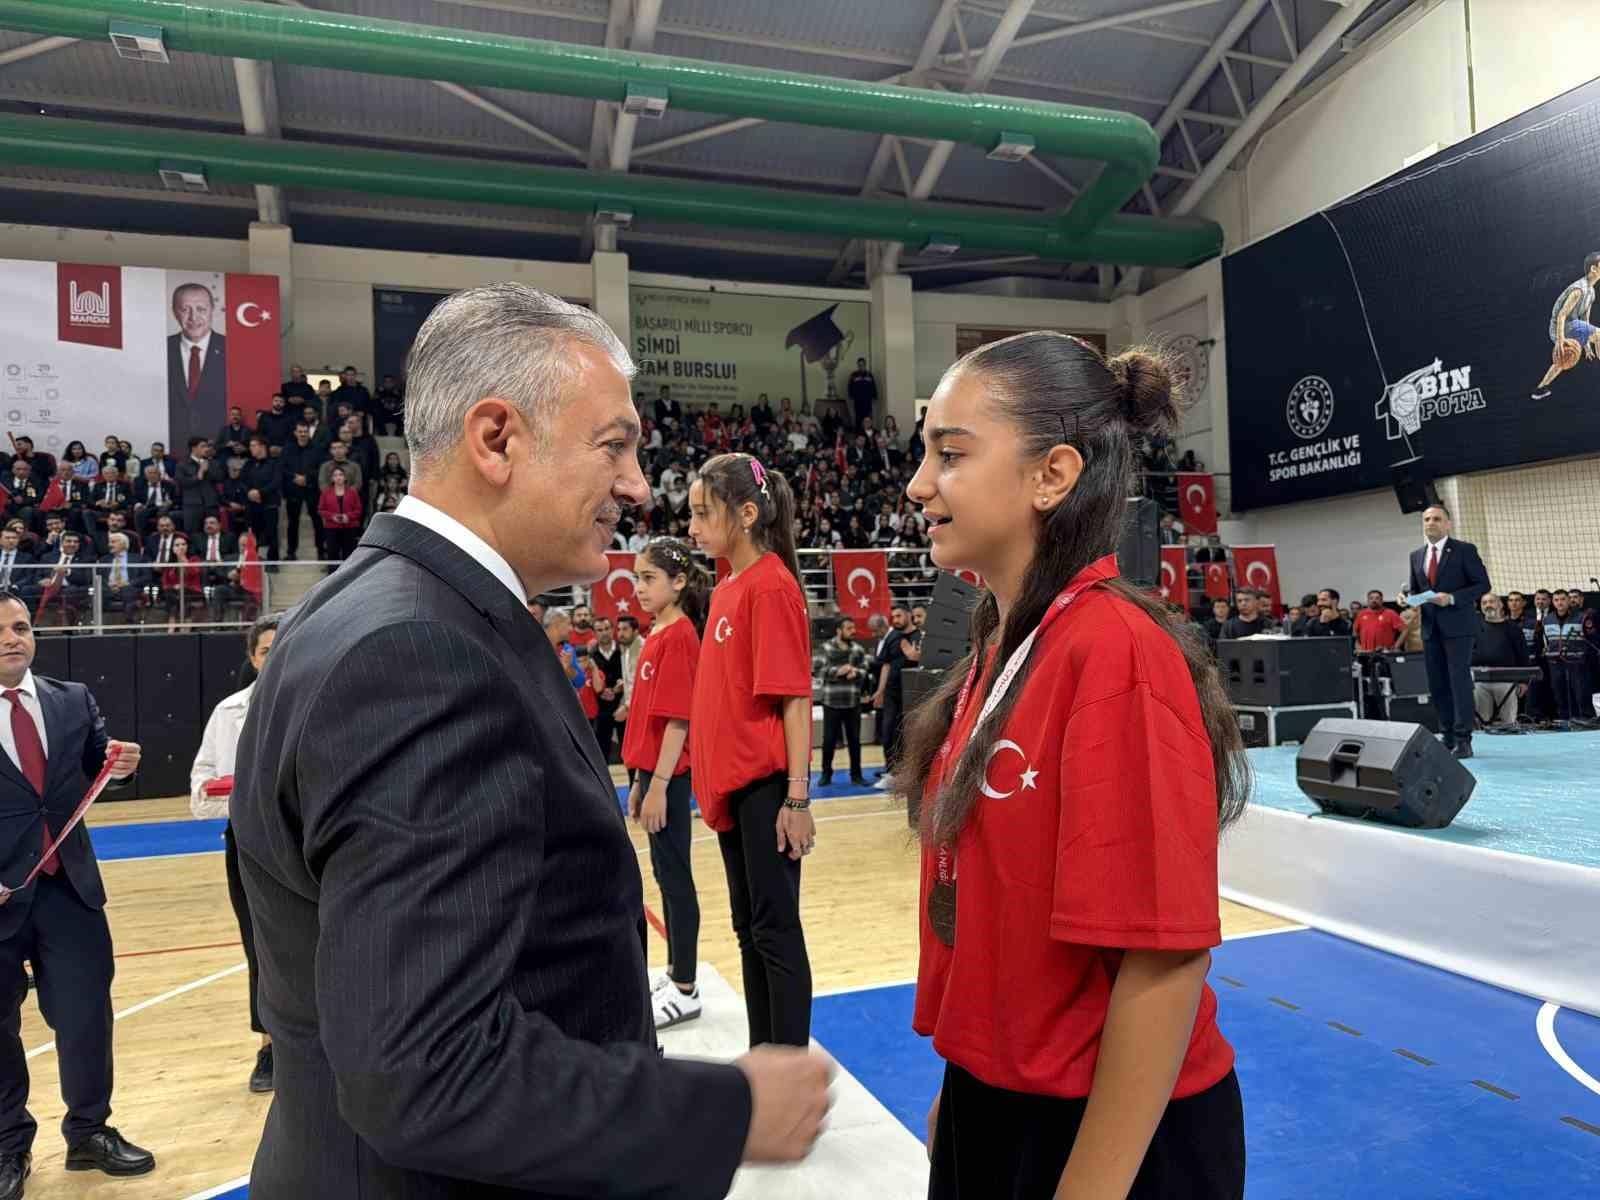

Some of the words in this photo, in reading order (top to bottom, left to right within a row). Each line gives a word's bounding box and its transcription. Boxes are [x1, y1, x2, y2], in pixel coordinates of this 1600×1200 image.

[638, 335, 681, 357] ŞİMDİ
[673, 361, 737, 380] BURSLU!
[1420, 388, 1487, 421] POTA
[1268, 451, 1289, 466] T.C.
[1290, 438, 1341, 460] GENÇLİK
[1343, 434, 1361, 449] VE
[1269, 465, 1298, 482] SPOR
[1299, 450, 1361, 476] BAKANLIĞI
